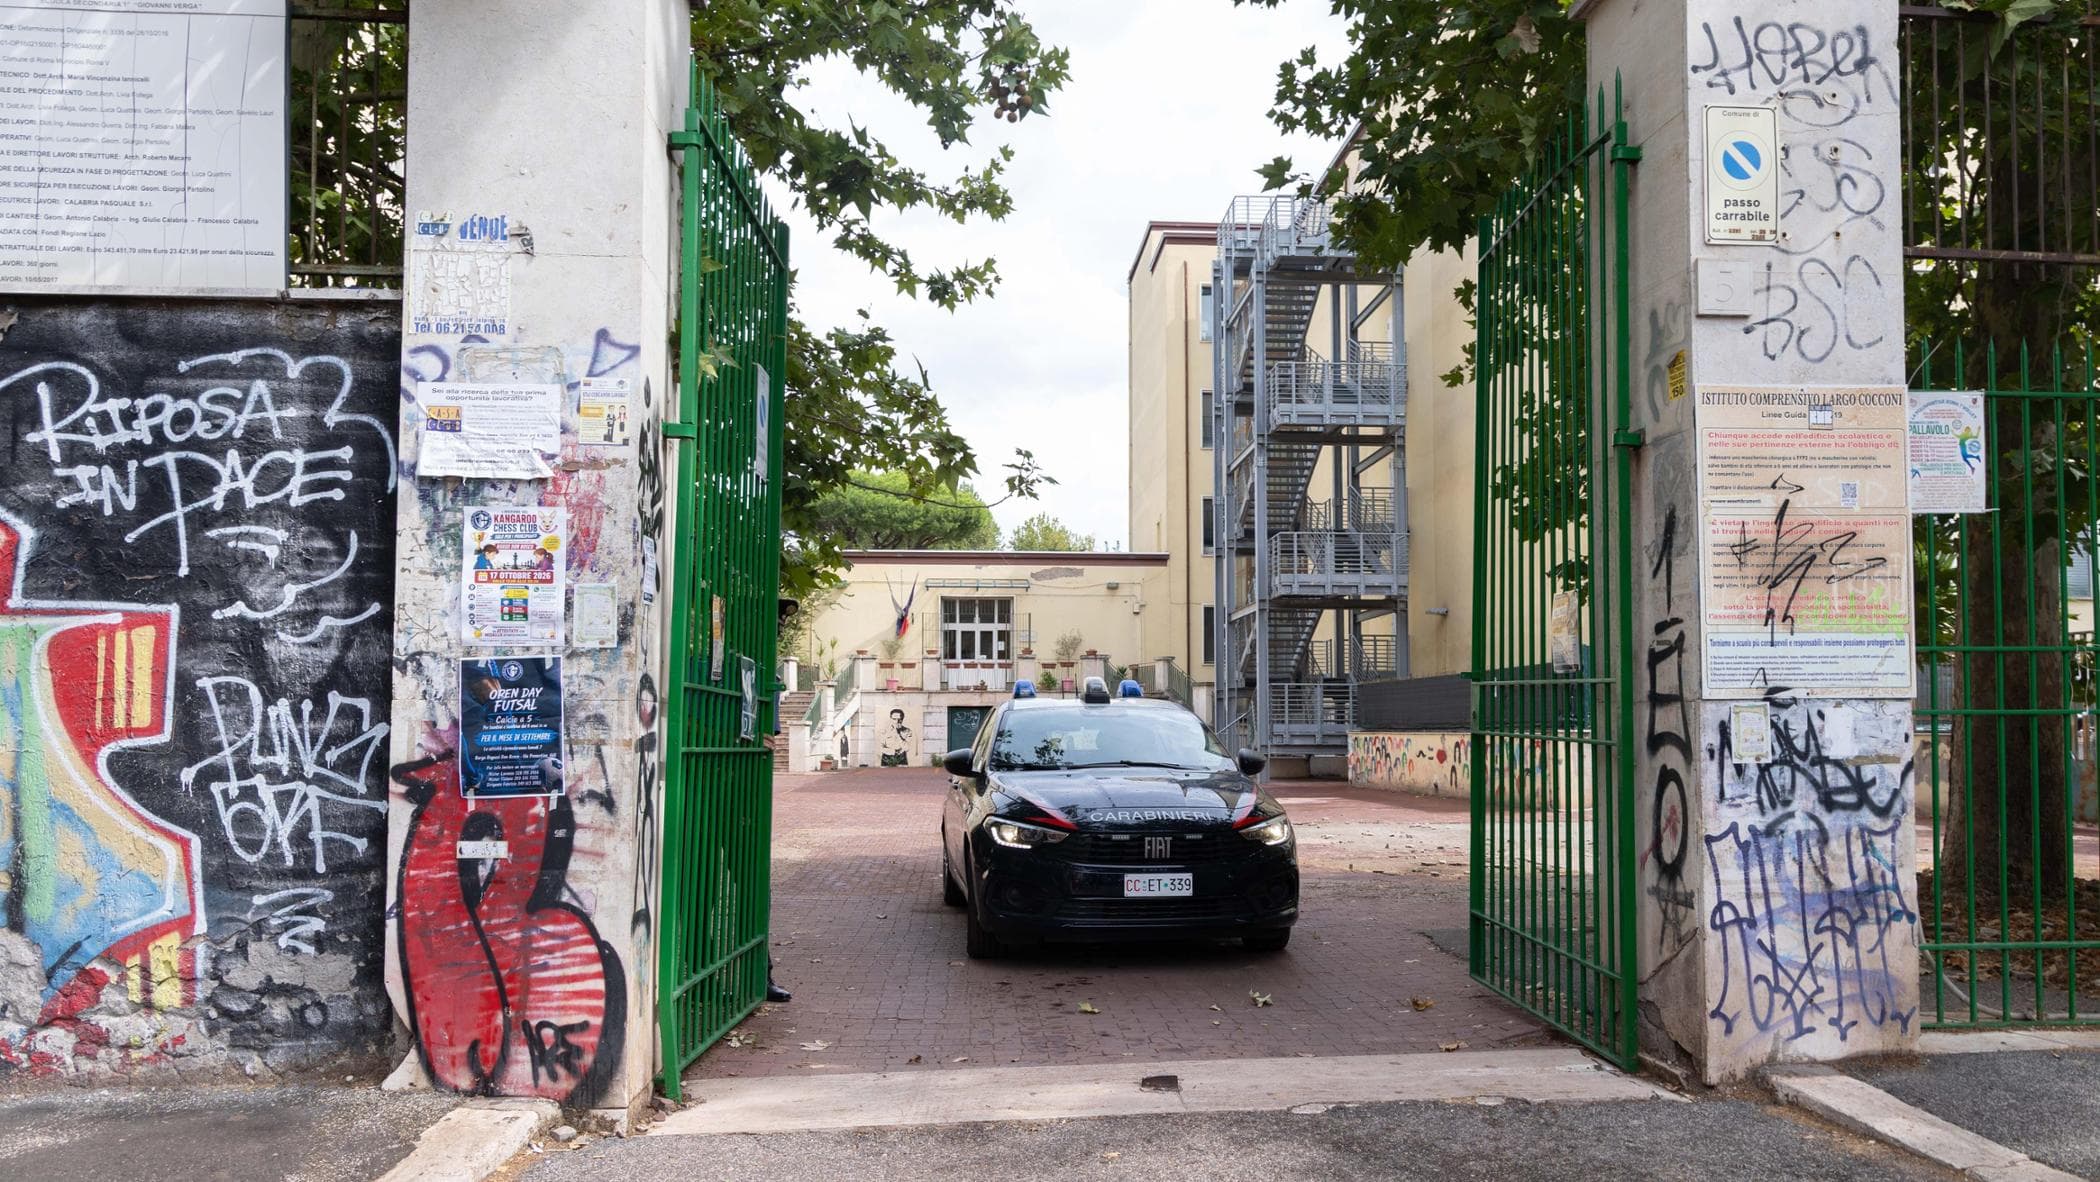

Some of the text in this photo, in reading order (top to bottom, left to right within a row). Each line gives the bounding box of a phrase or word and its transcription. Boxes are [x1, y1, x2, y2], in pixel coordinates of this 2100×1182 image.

[1724, 199, 1761, 208] passo
[1715, 211, 1770, 222] carrabile
[1702, 392, 1747, 405] ISTITUTO
[1749, 392, 1820, 406] COMPRENSIVO
[1858, 393, 1902, 406] COCCONI
[0, 362, 295, 462] RIPOSA
[1708, 431, 1749, 440] Chiunque
[1750, 440, 1797, 449] pertinenze
[55, 446, 354, 577] IN PACE
[493, 513, 538, 523] KANGAROO
[493, 523, 538, 533] CHESS CLUB
[490, 571, 499, 580] 17
[500, 571, 532, 580] OTTOBRE
[489, 686, 543, 700] OPEN DAY
[493, 698, 538, 713] FUTSAL
[495, 715, 518, 724] Calcio
[527, 714, 533, 723] 5
[1090, 810, 1211, 821] CARABINIERI
[1145, 836, 1173, 859] FIAT
[1126, 878, 1192, 892] CC ET 339
